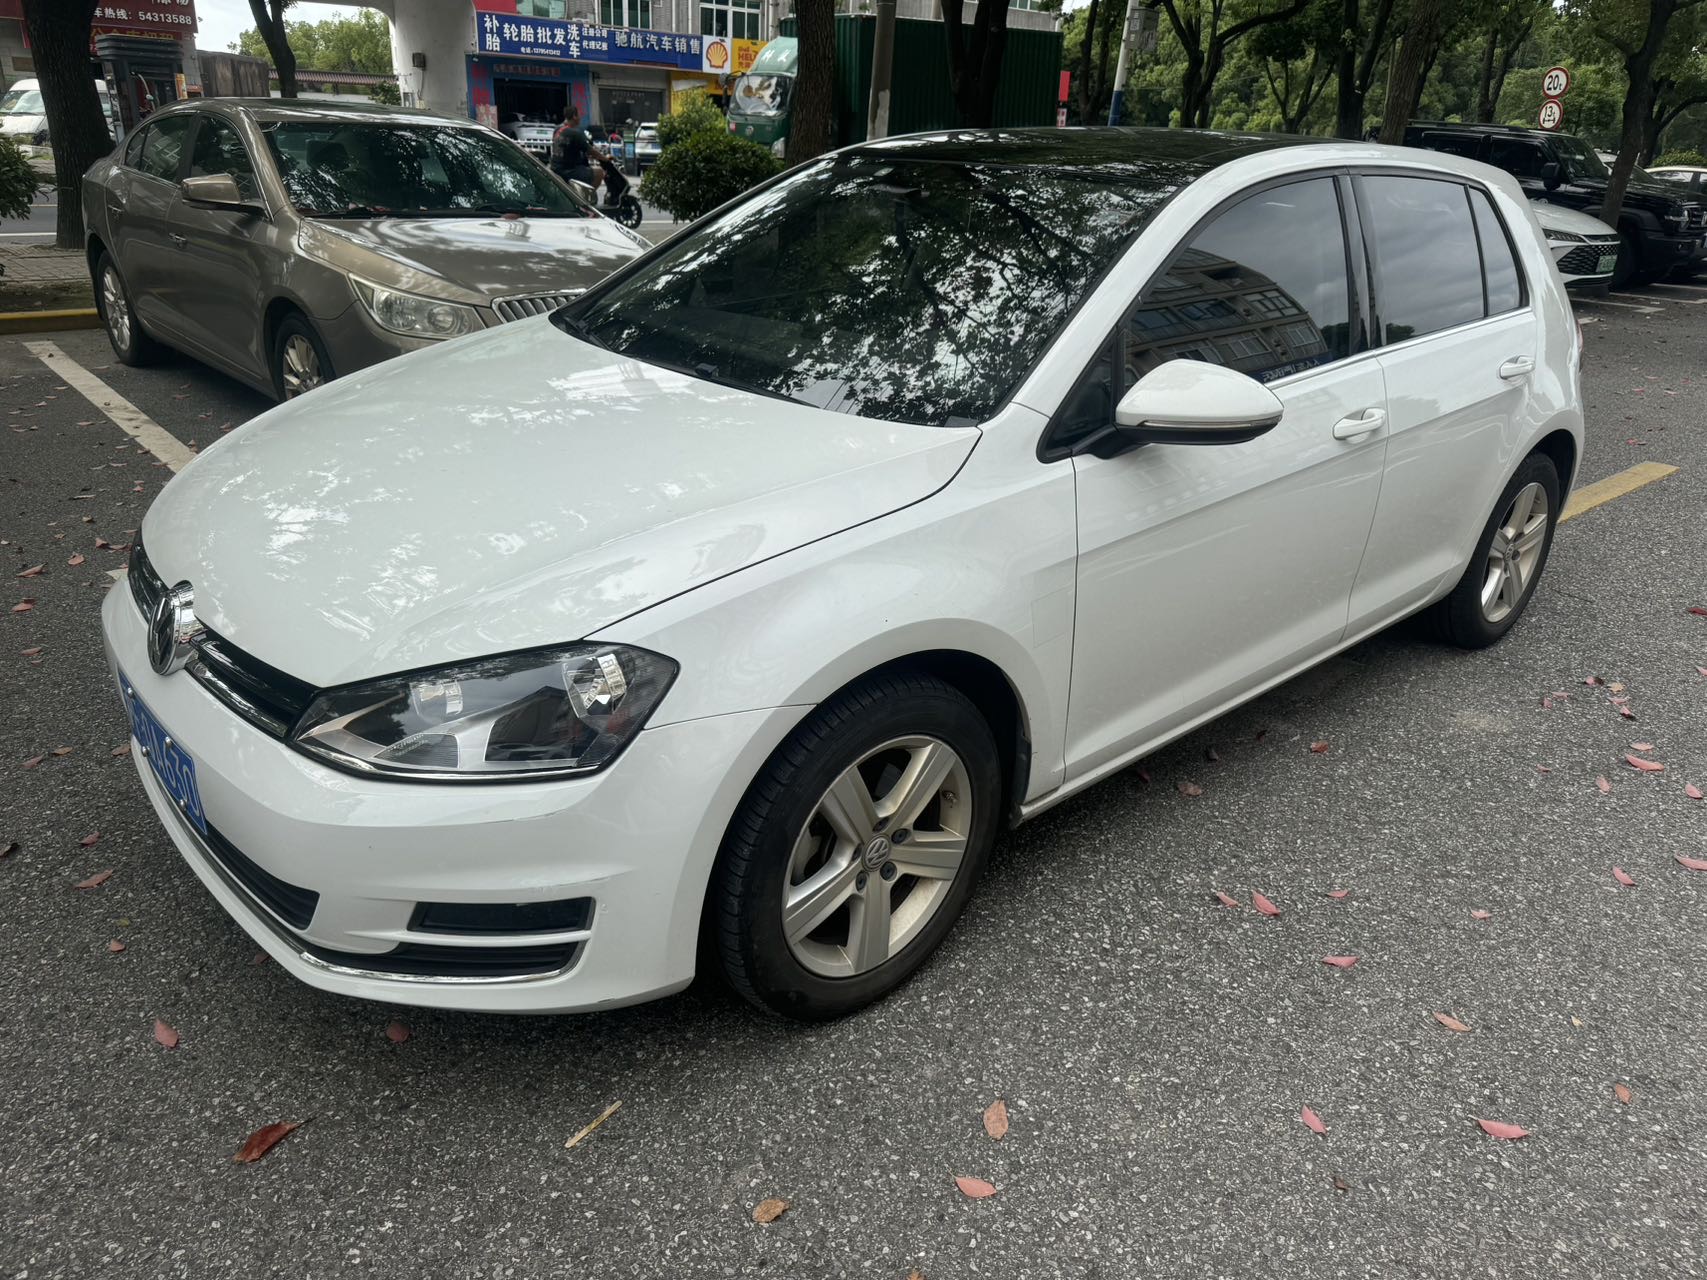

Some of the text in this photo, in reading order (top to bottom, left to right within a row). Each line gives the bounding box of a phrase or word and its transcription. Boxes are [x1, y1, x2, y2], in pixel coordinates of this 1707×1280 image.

[484, 14, 501, 51] 补胎
[503, 22, 566, 46] 轮胎批发
[567, 24, 581, 58] 洗车
[582, 27, 608, 38] 注册公司
[615, 31, 701, 55] 驰航汽车销售
[1547, 74, 1562, 91] 20t
